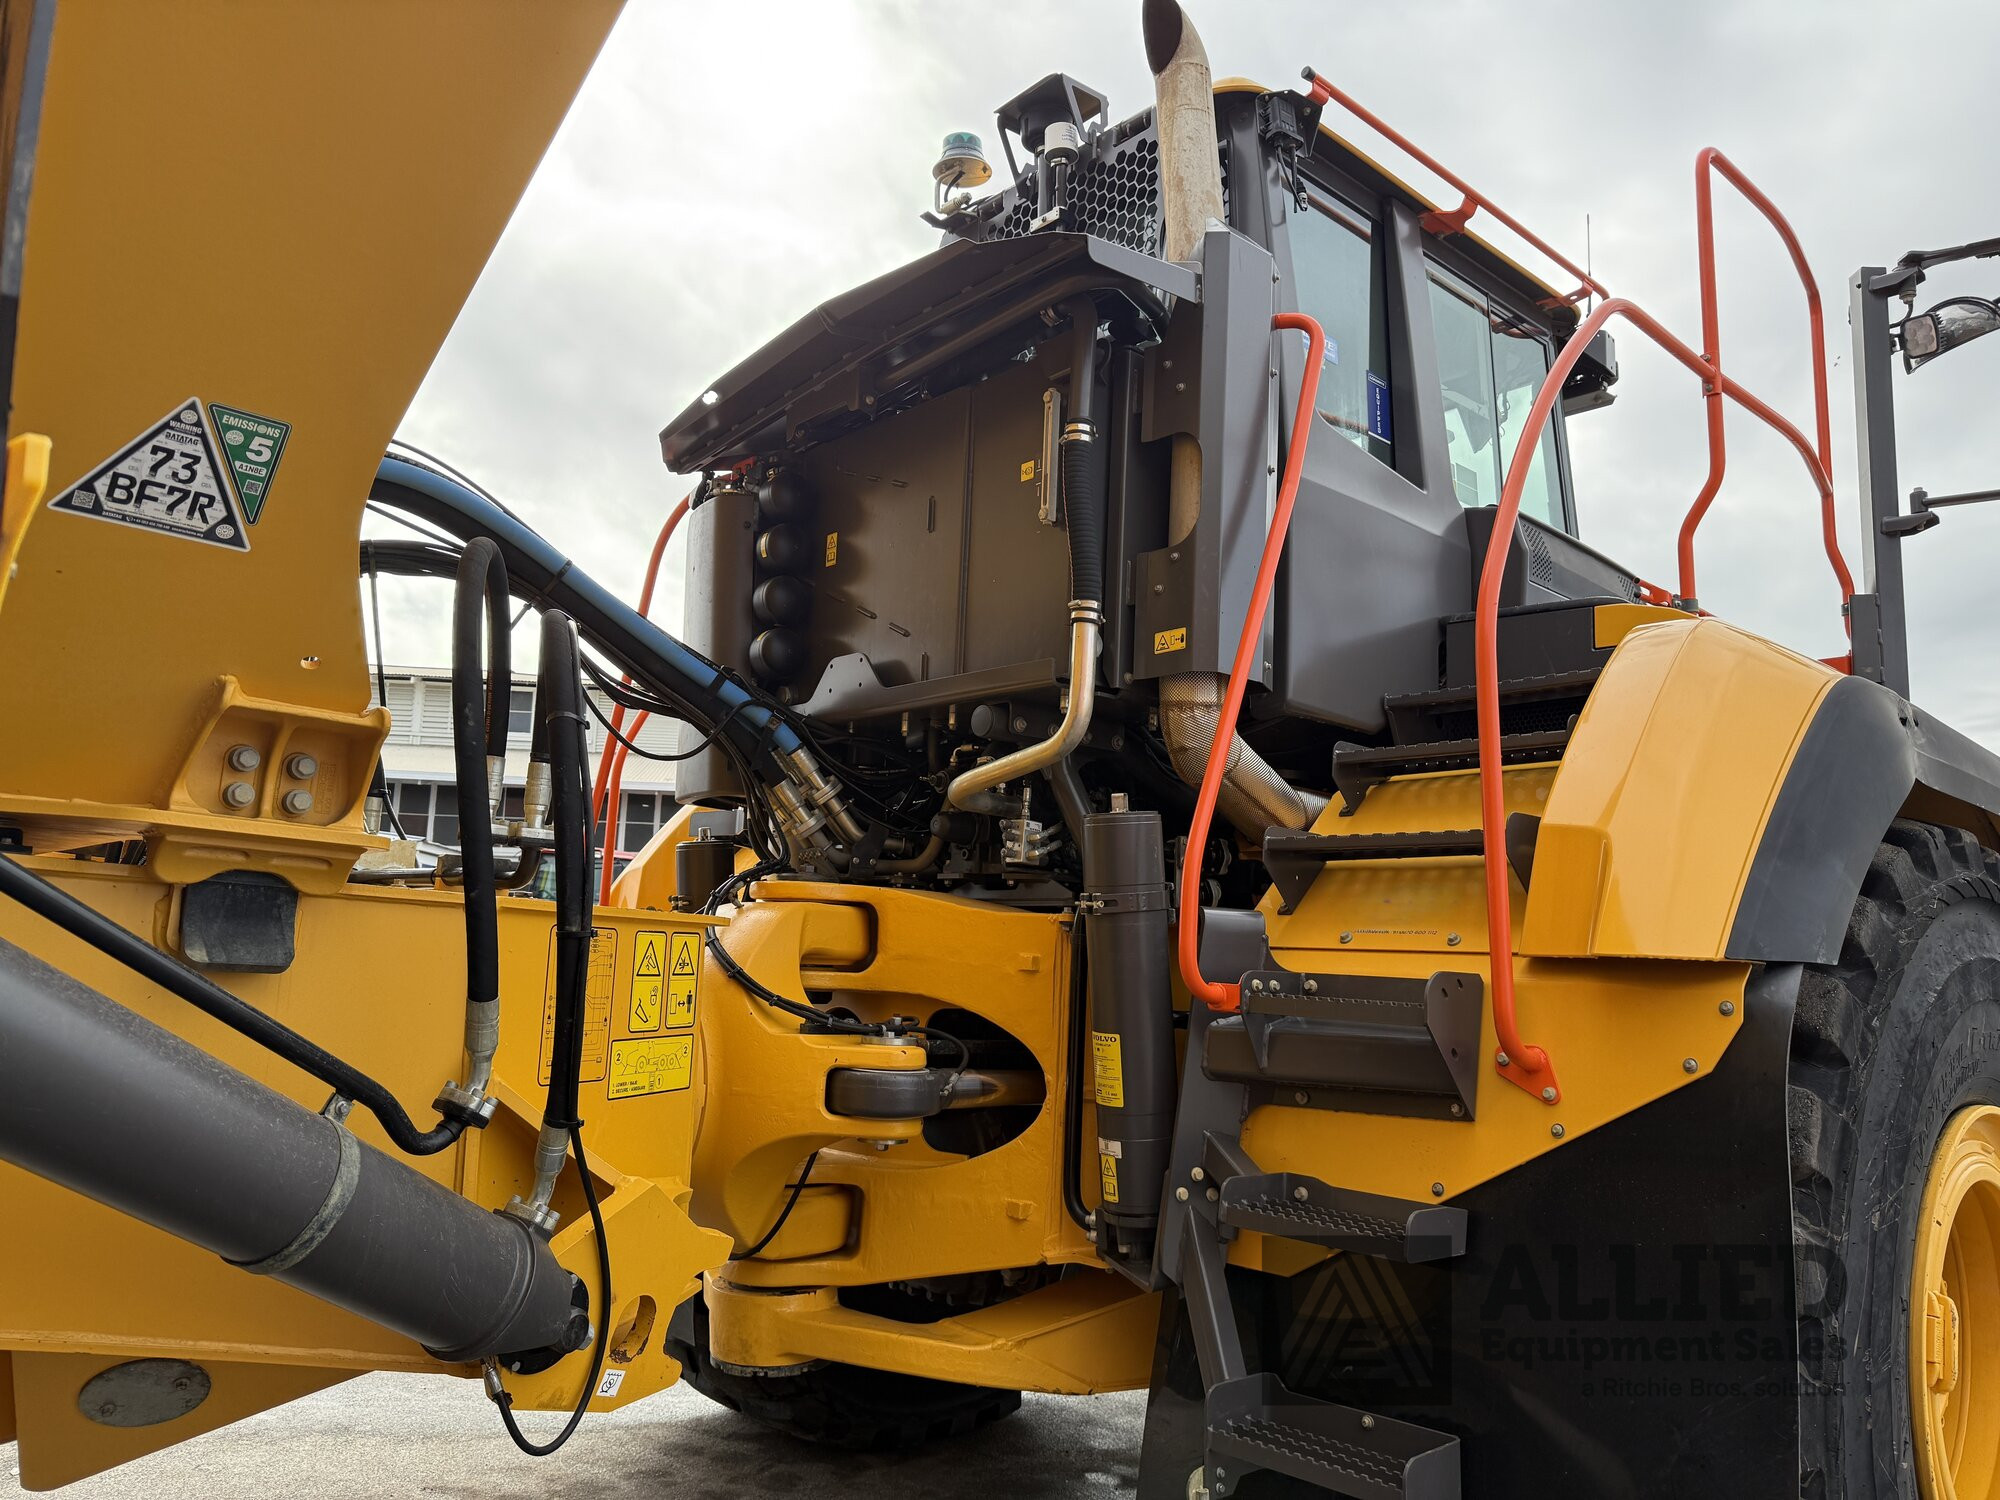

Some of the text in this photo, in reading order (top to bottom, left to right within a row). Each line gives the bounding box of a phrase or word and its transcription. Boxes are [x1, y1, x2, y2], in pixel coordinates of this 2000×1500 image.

[169, 419, 203, 435] WARNING
[165, 430, 200, 446] DATATAG
[245, 435, 274, 463] 5
[149, 444, 202, 485] 73
[105, 471, 217, 525] BF7R
[616, 1052, 621, 1061] 2
[683, 1046, 688, 1054] 2
